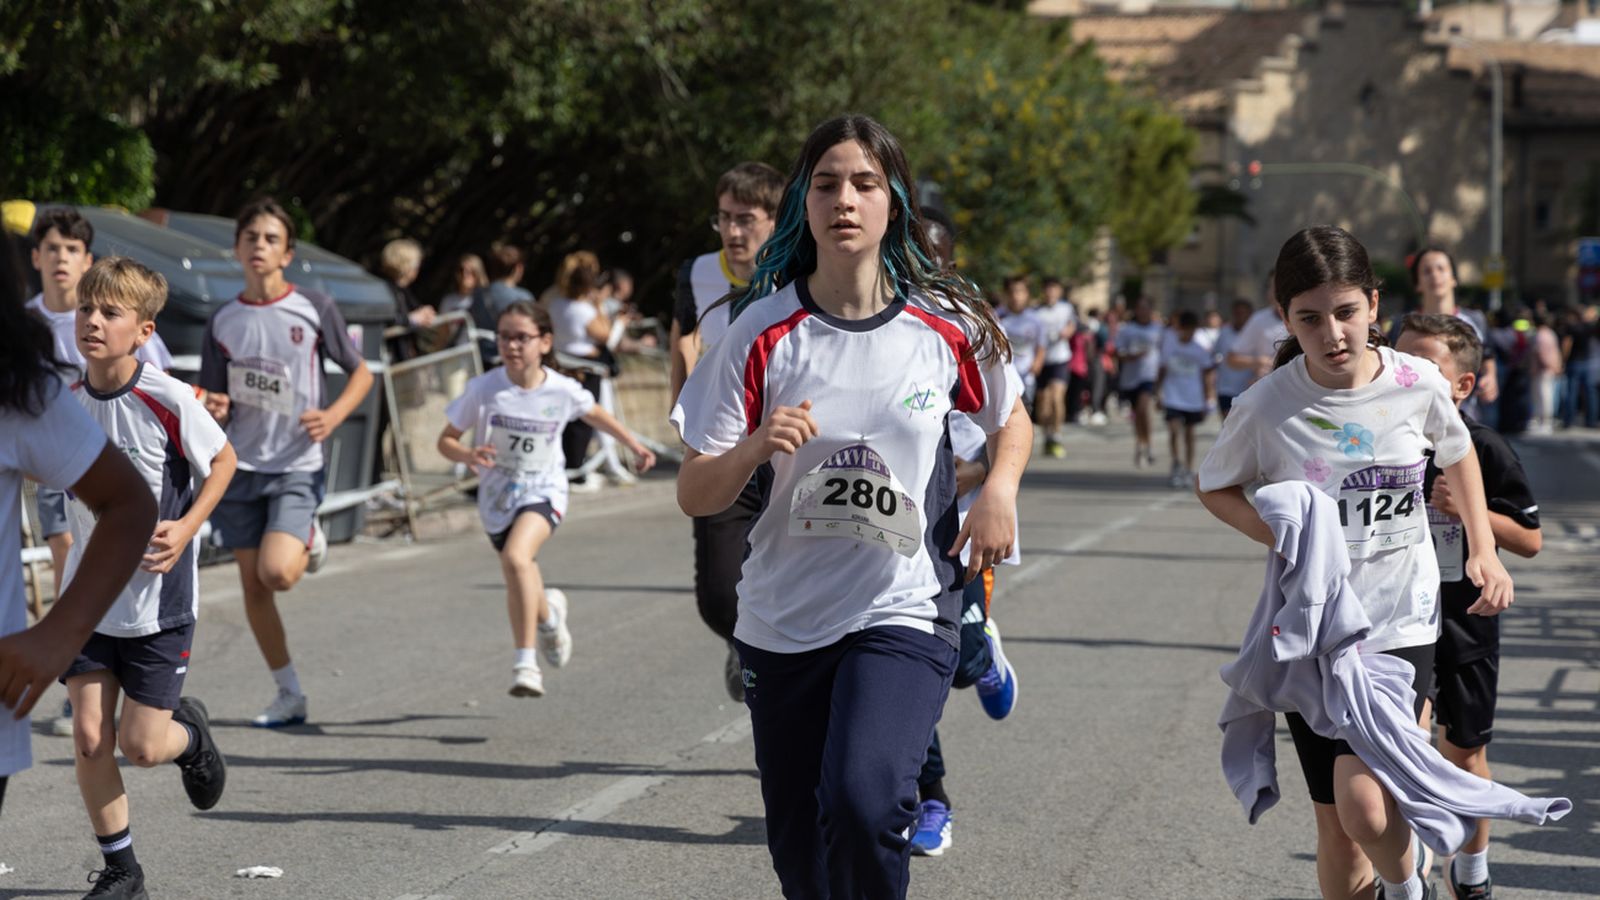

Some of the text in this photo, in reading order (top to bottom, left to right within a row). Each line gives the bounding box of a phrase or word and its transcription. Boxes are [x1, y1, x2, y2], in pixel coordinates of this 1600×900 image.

[246, 371, 280, 394] 884
[508, 434, 534, 454] 76
[822, 477, 897, 517] 280
[1337, 490, 1416, 527] 1124
